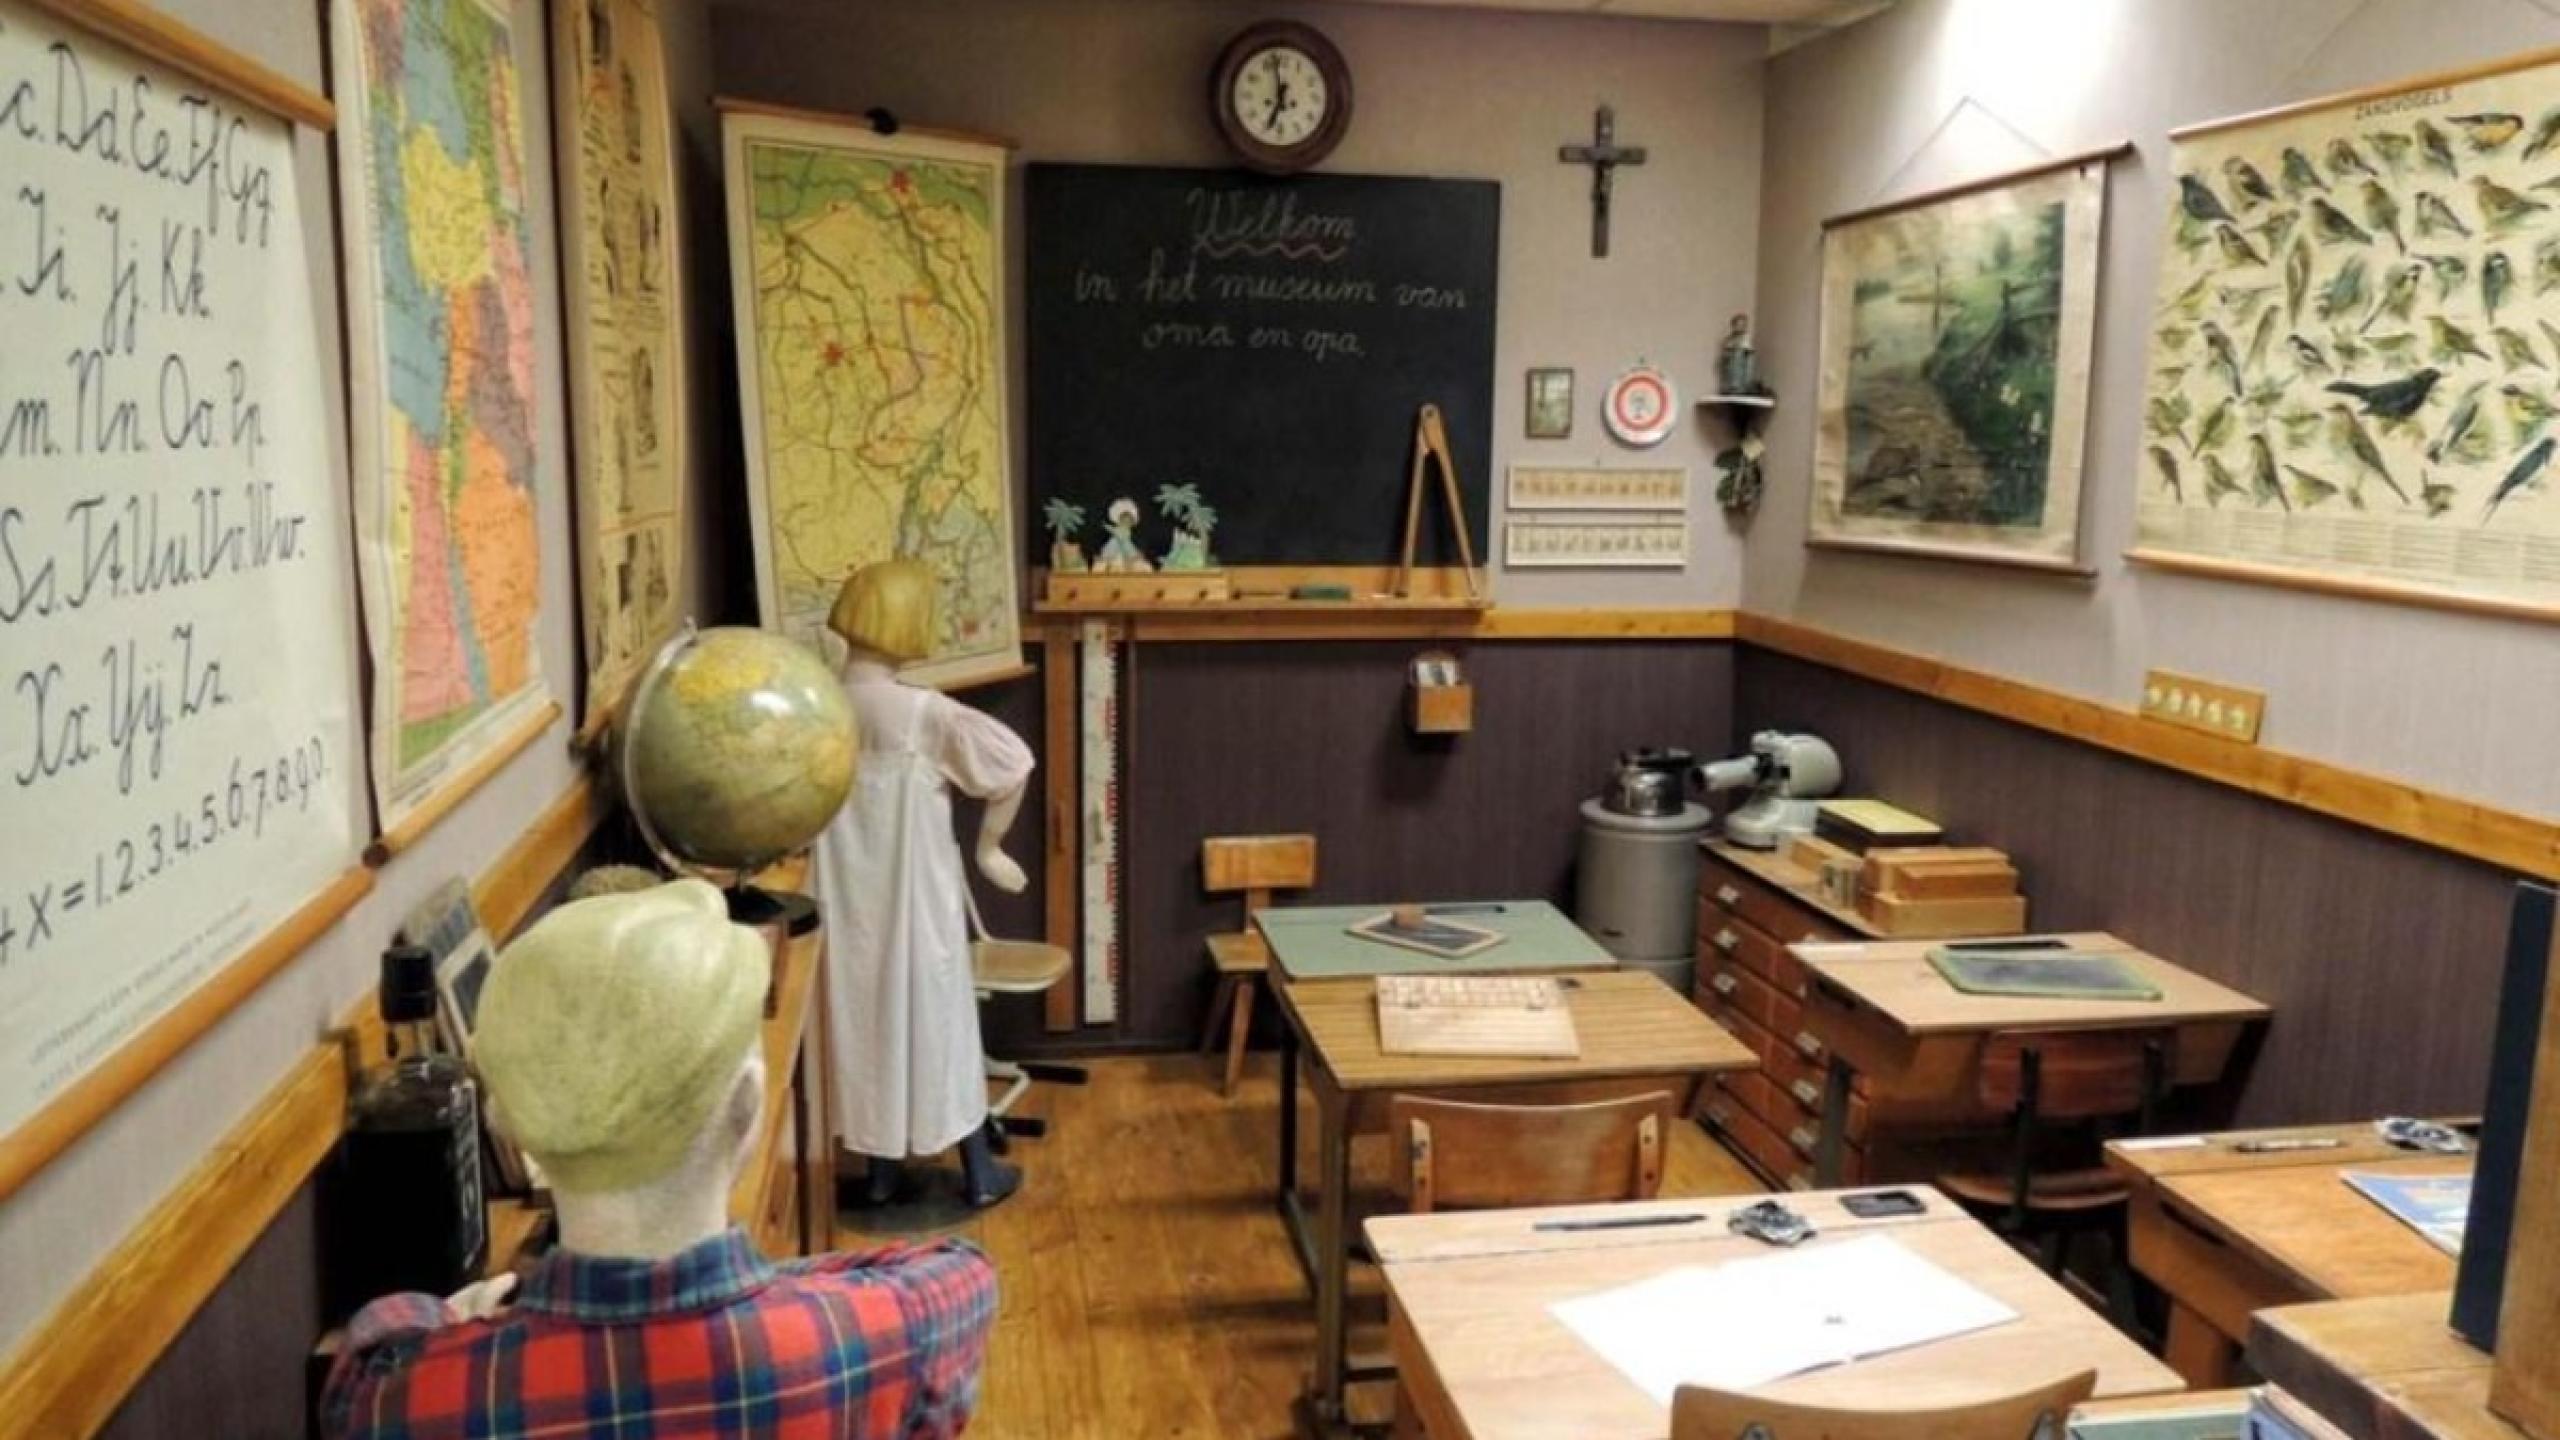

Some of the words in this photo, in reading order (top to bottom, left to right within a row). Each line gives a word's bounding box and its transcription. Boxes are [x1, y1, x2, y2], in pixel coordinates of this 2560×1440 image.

[1185, 187, 1354, 241] Welkom
[1075, 265, 1117, 304] in
[1138, 247, 1201, 304] het
[1211, 273, 1377, 305] museum
[1394, 283, 1467, 309] van
[1141, 322, 1235, 349] oma
[1248, 325, 1292, 348] en
